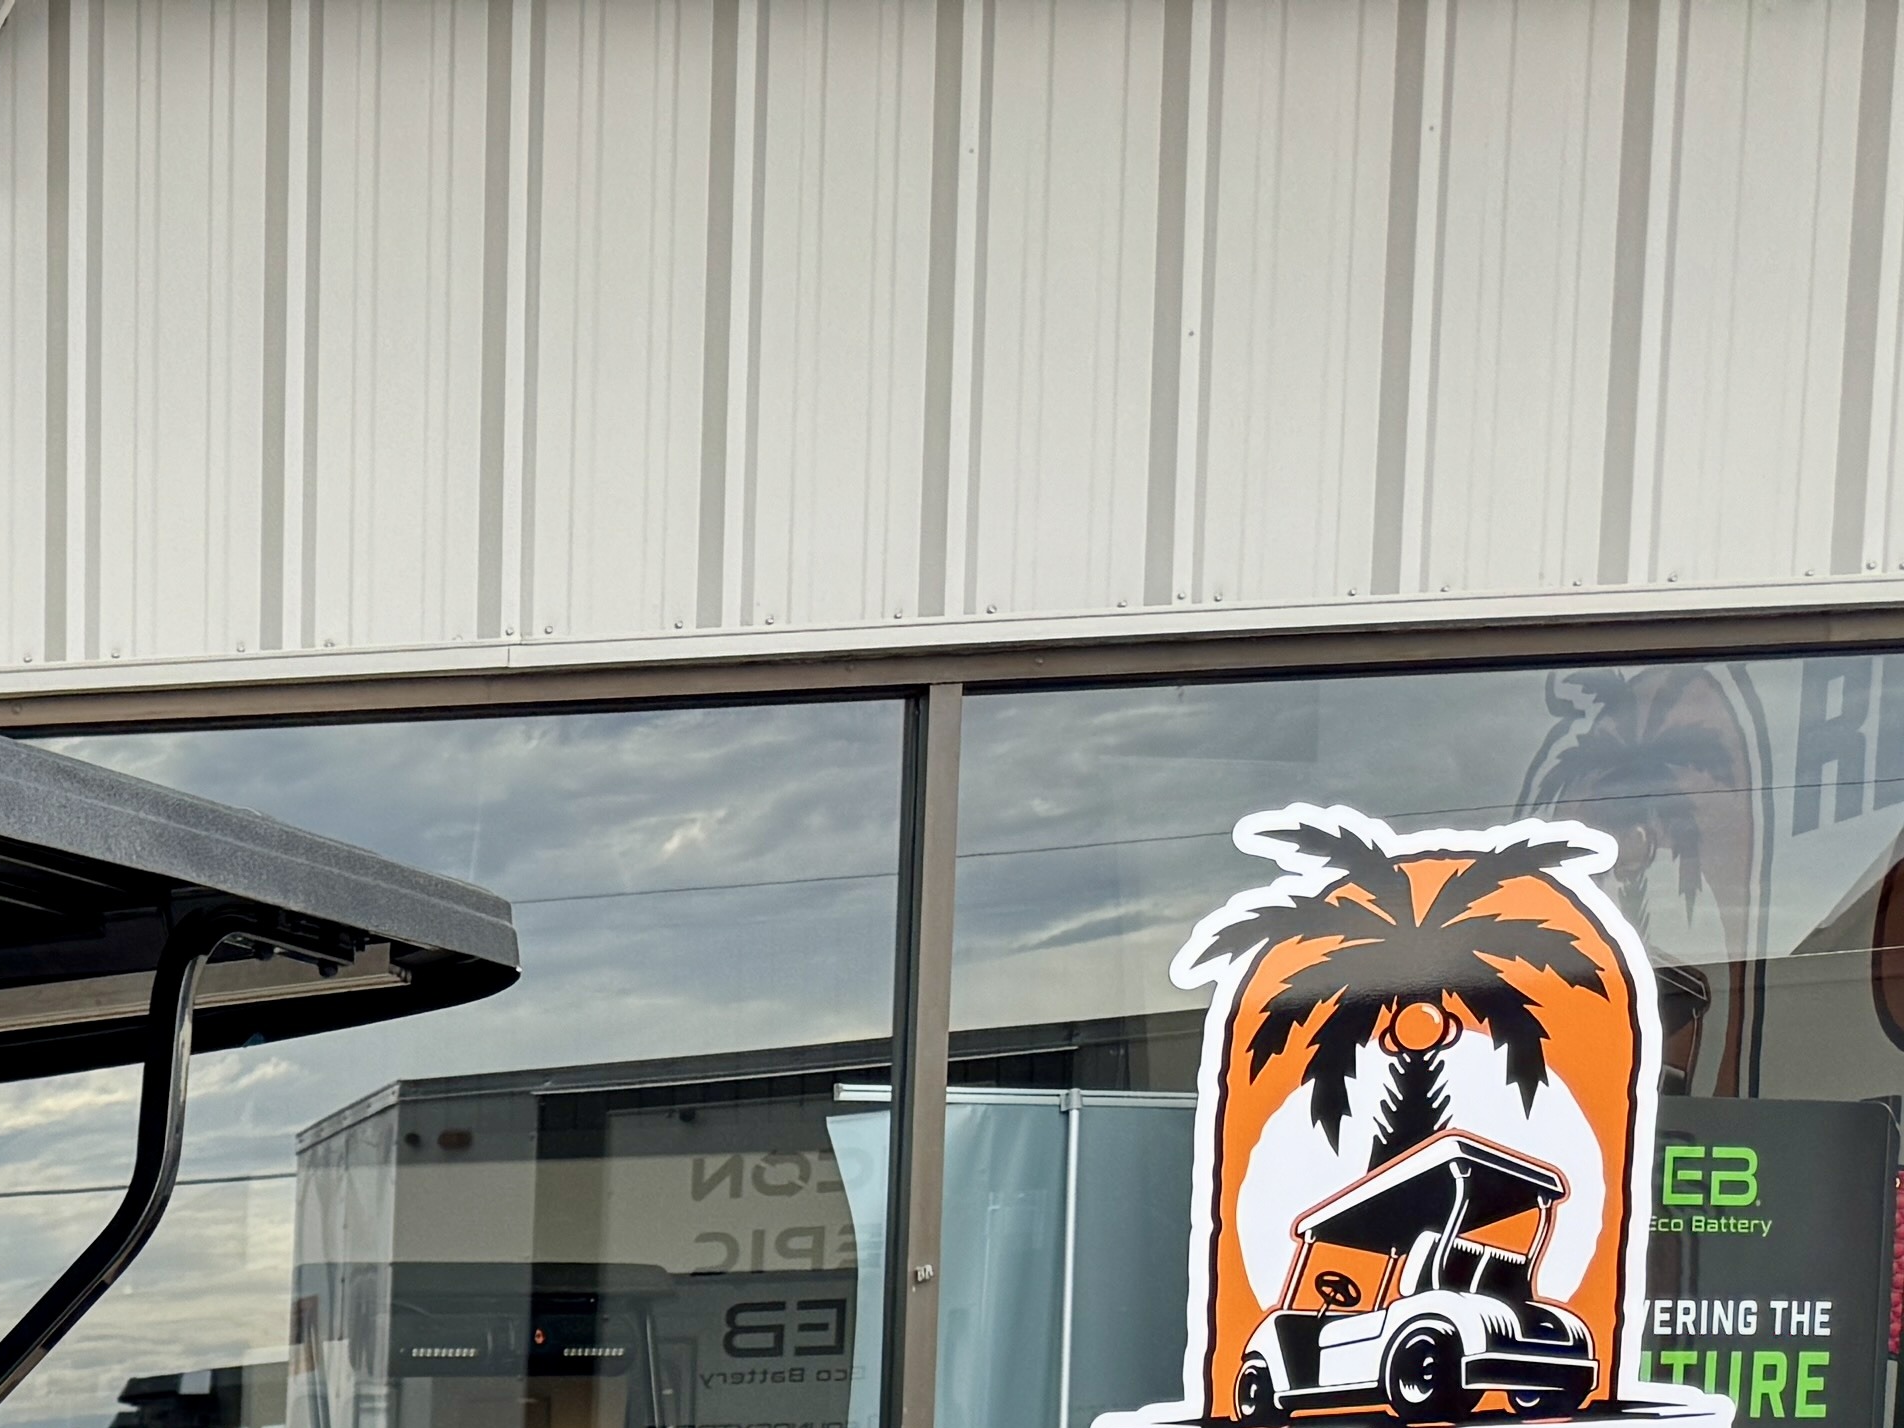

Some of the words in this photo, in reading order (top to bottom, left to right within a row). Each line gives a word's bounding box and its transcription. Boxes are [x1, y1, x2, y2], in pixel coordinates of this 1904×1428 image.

[1662, 1146, 1759, 1207] EB
[1692, 1215, 1772, 1238] Battery
[1643, 1300, 1758, 1336] ERING
[1770, 1300, 1833, 1336] THE
